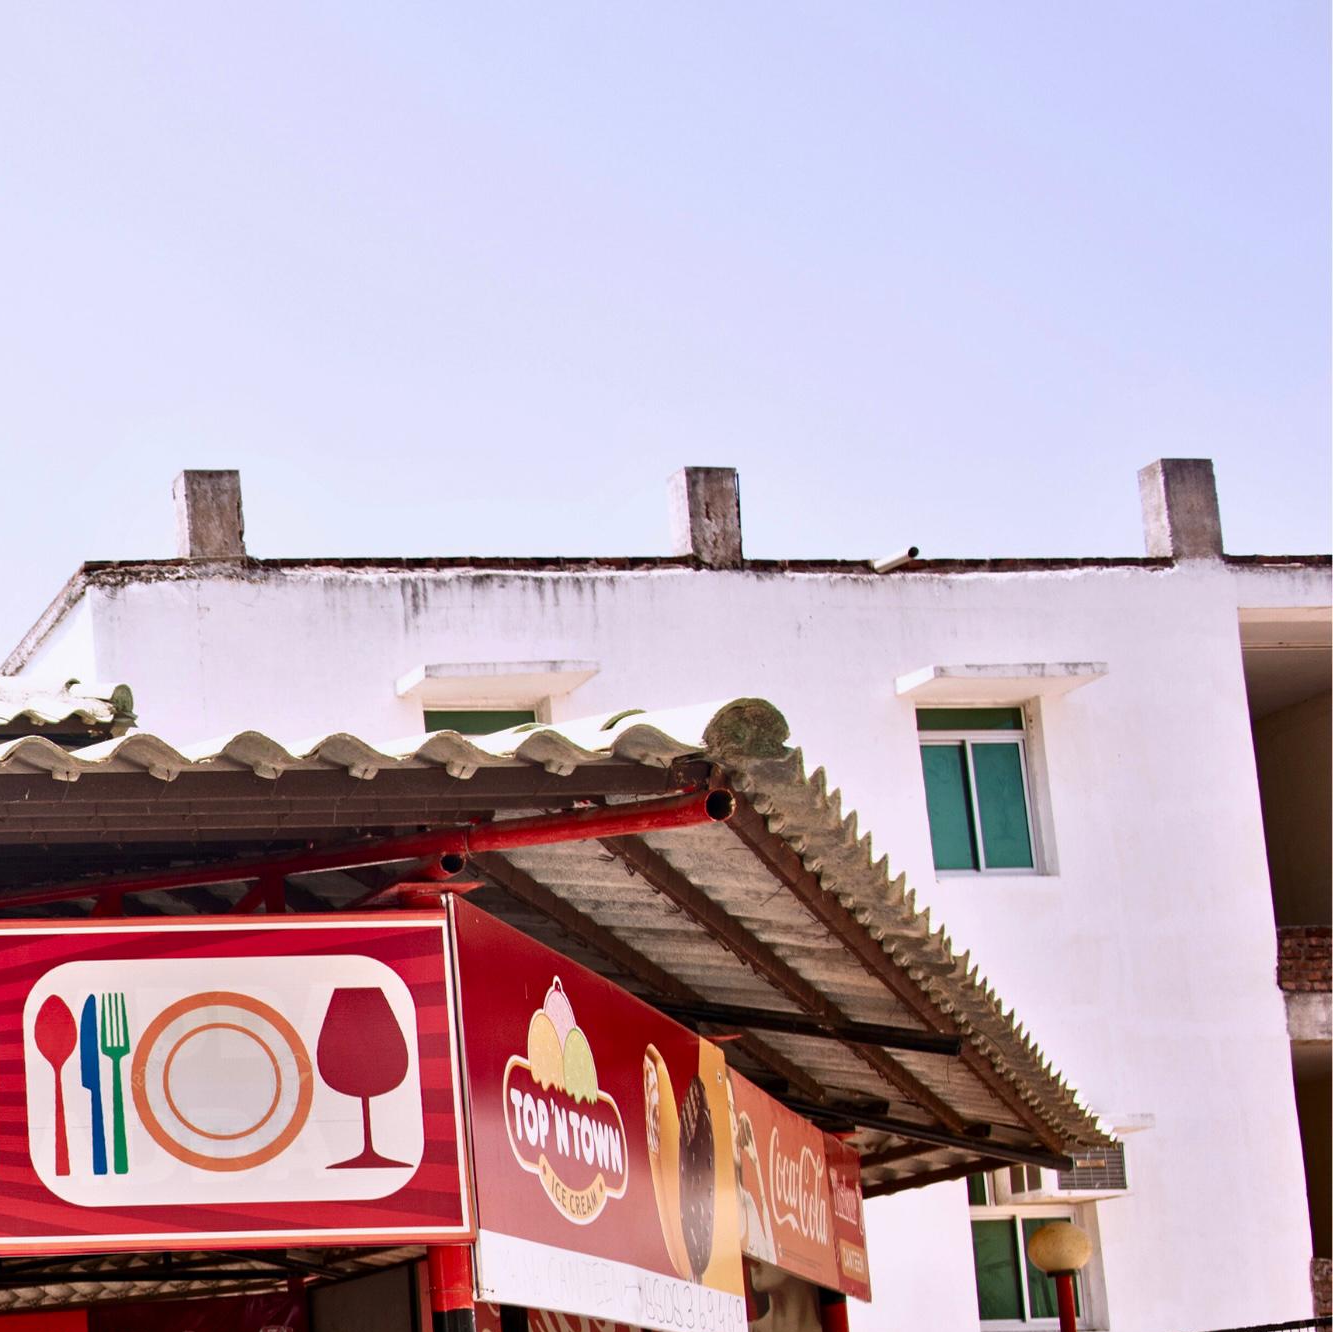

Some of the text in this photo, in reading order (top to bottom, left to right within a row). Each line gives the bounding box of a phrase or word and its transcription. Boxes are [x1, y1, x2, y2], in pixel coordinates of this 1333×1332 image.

[510, 1088, 549, 1149] TOP
[569, 1110, 623, 1175] TOWN
[551, 1176, 598, 1216] ICE CREAM
[770, 1126, 829, 1246] Coca-Cola
